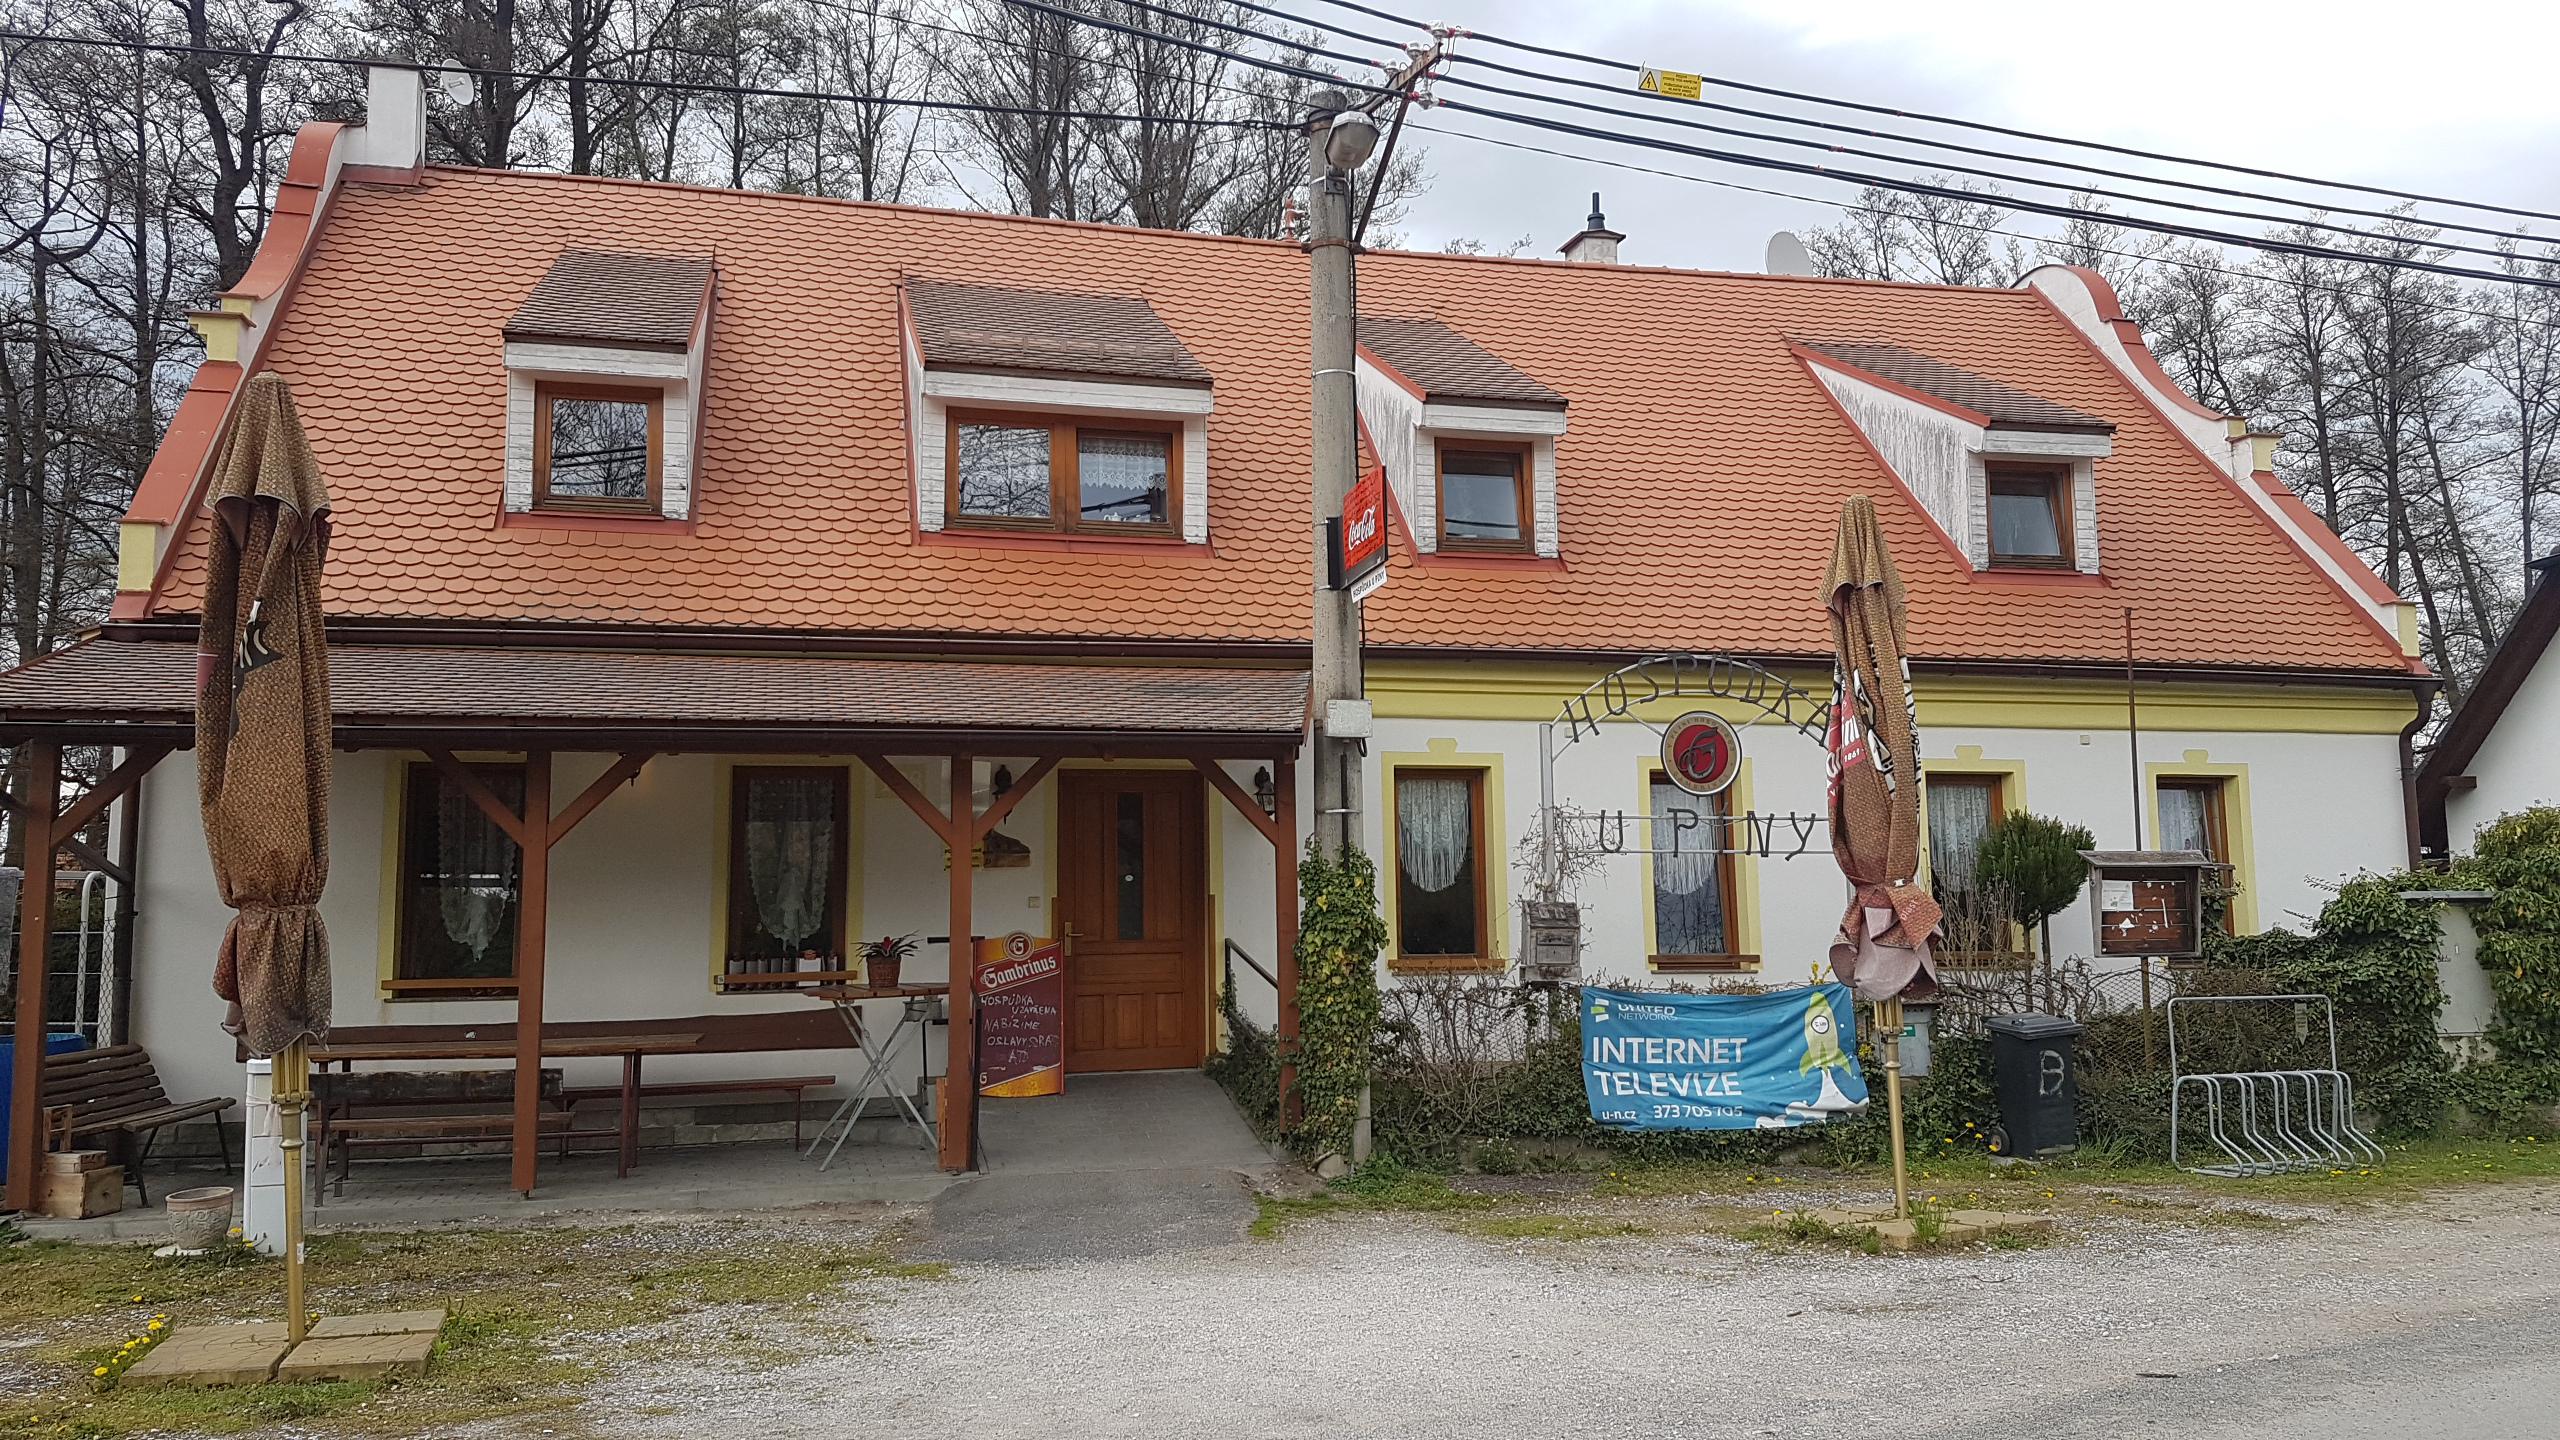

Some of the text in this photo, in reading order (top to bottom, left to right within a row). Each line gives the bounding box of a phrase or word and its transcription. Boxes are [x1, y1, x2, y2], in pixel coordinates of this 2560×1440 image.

[1599, 810, 1624, 853] U
[980, 955, 1057, 988] Gambrinus
[1618, 1012, 1678, 1021] NETWORKS
[1593, 1037, 1748, 1064] INTERNET
[1592, 1070, 1743, 1097] TELEVIZE
[1602, 1109, 1637, 1121] u-n.cz
[1653, 1104, 1681, 1119] 373
[1682, 1105, 1712, 1118] 705
